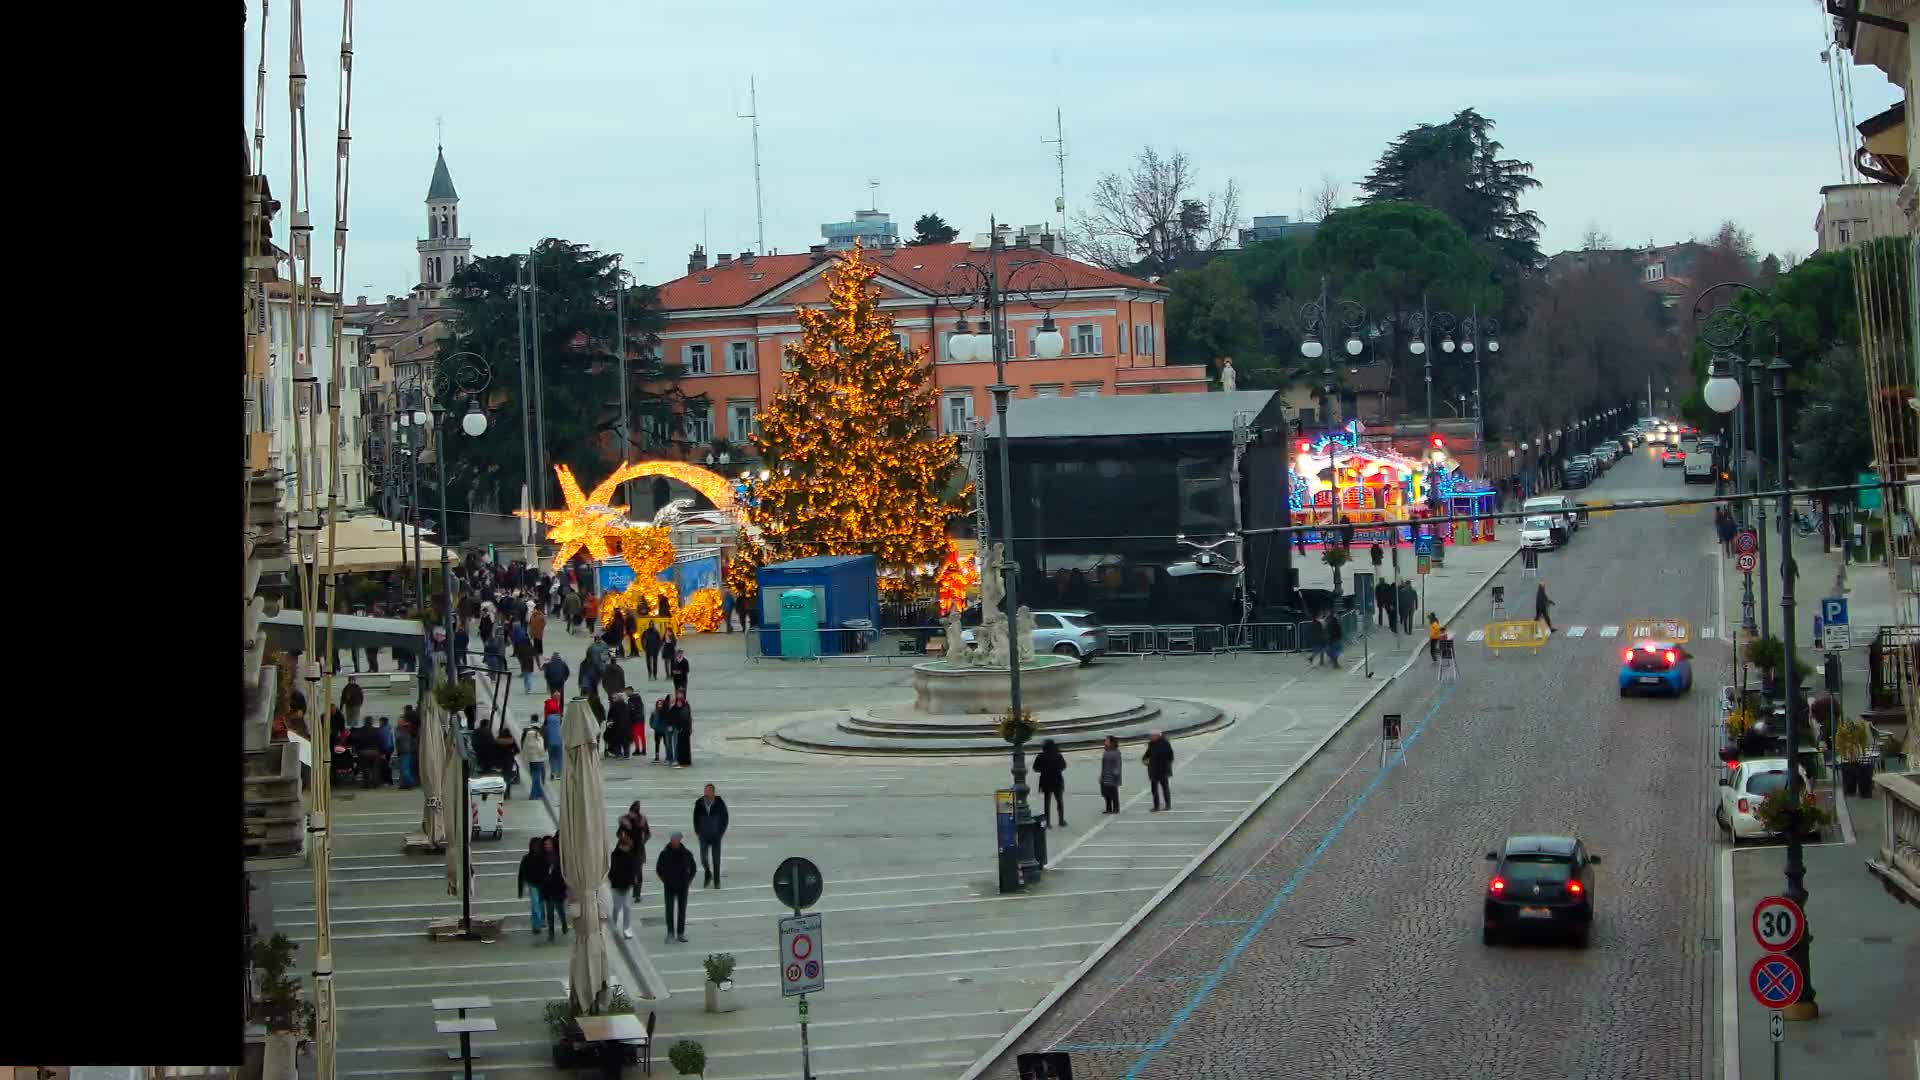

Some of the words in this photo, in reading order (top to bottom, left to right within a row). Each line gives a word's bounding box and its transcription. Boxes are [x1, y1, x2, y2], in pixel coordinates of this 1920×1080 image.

[1742, 557, 1753, 567] 20
[1827, 602, 1842, 621] P
[1762, 911, 1792, 938] 30
